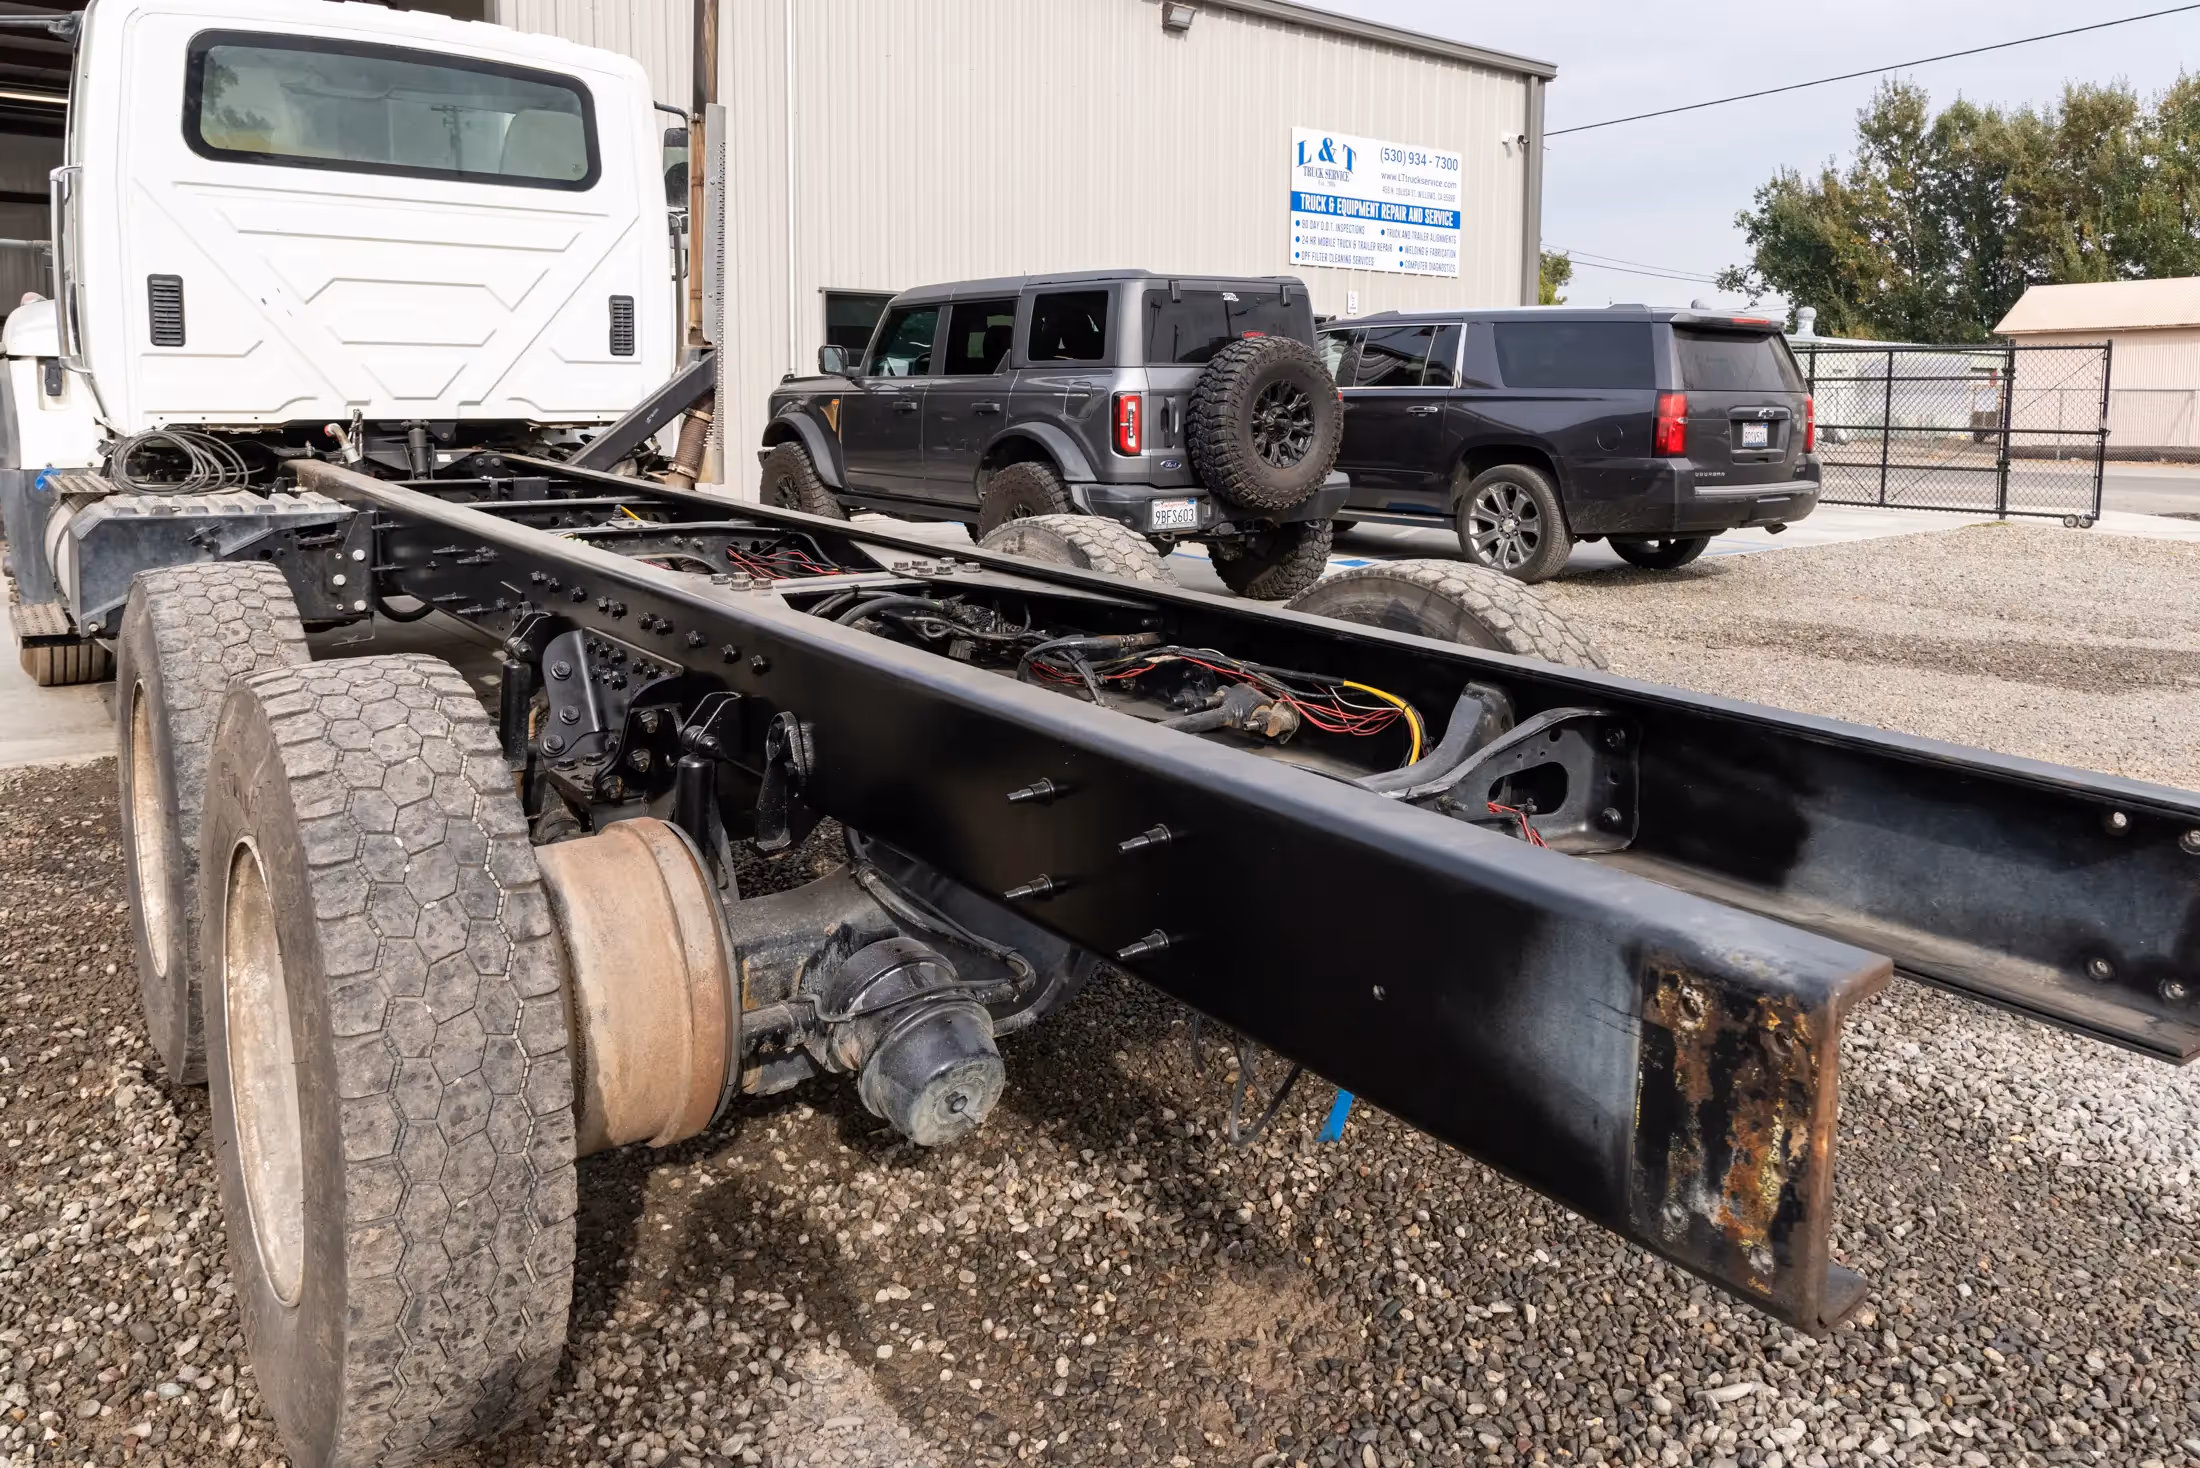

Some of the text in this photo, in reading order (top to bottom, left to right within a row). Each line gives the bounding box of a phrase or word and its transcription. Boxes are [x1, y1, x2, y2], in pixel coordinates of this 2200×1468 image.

[1297, 137, 1357, 174] L & T
[1380, 147, 1406, 167] (530)
[1408, 152, 1426, 166] 934
[1435, 155, 1458, 171] 7300
[1303, 166, 1349, 182] TRUCK SERVICE
[1300, 194, 1453, 227] TRUCK & EQUIPMENT REPAIR AND SERVICE
[1310, 220, 1320, 230] DAY
[1335, 222, 1365, 235] INSPECTIONS
[1302, 235, 1393, 253] 24 HR MOBILE TRUCK & TRAILER REPAIR
[1386, 228, 1457, 245] TRUCK AND TRAILER ALIGNMENTS
[1302, 251, 1375, 266] DPF FILTER CLEANING SERVICES
[1404, 245, 1424, 256] WELDING
[1430, 247, 1457, 259] FABRICATION
[1404, 260, 1456, 273] COMPUTER DIAGNOSTICS
[1155, 508, 1194, 524] 9BFS603
